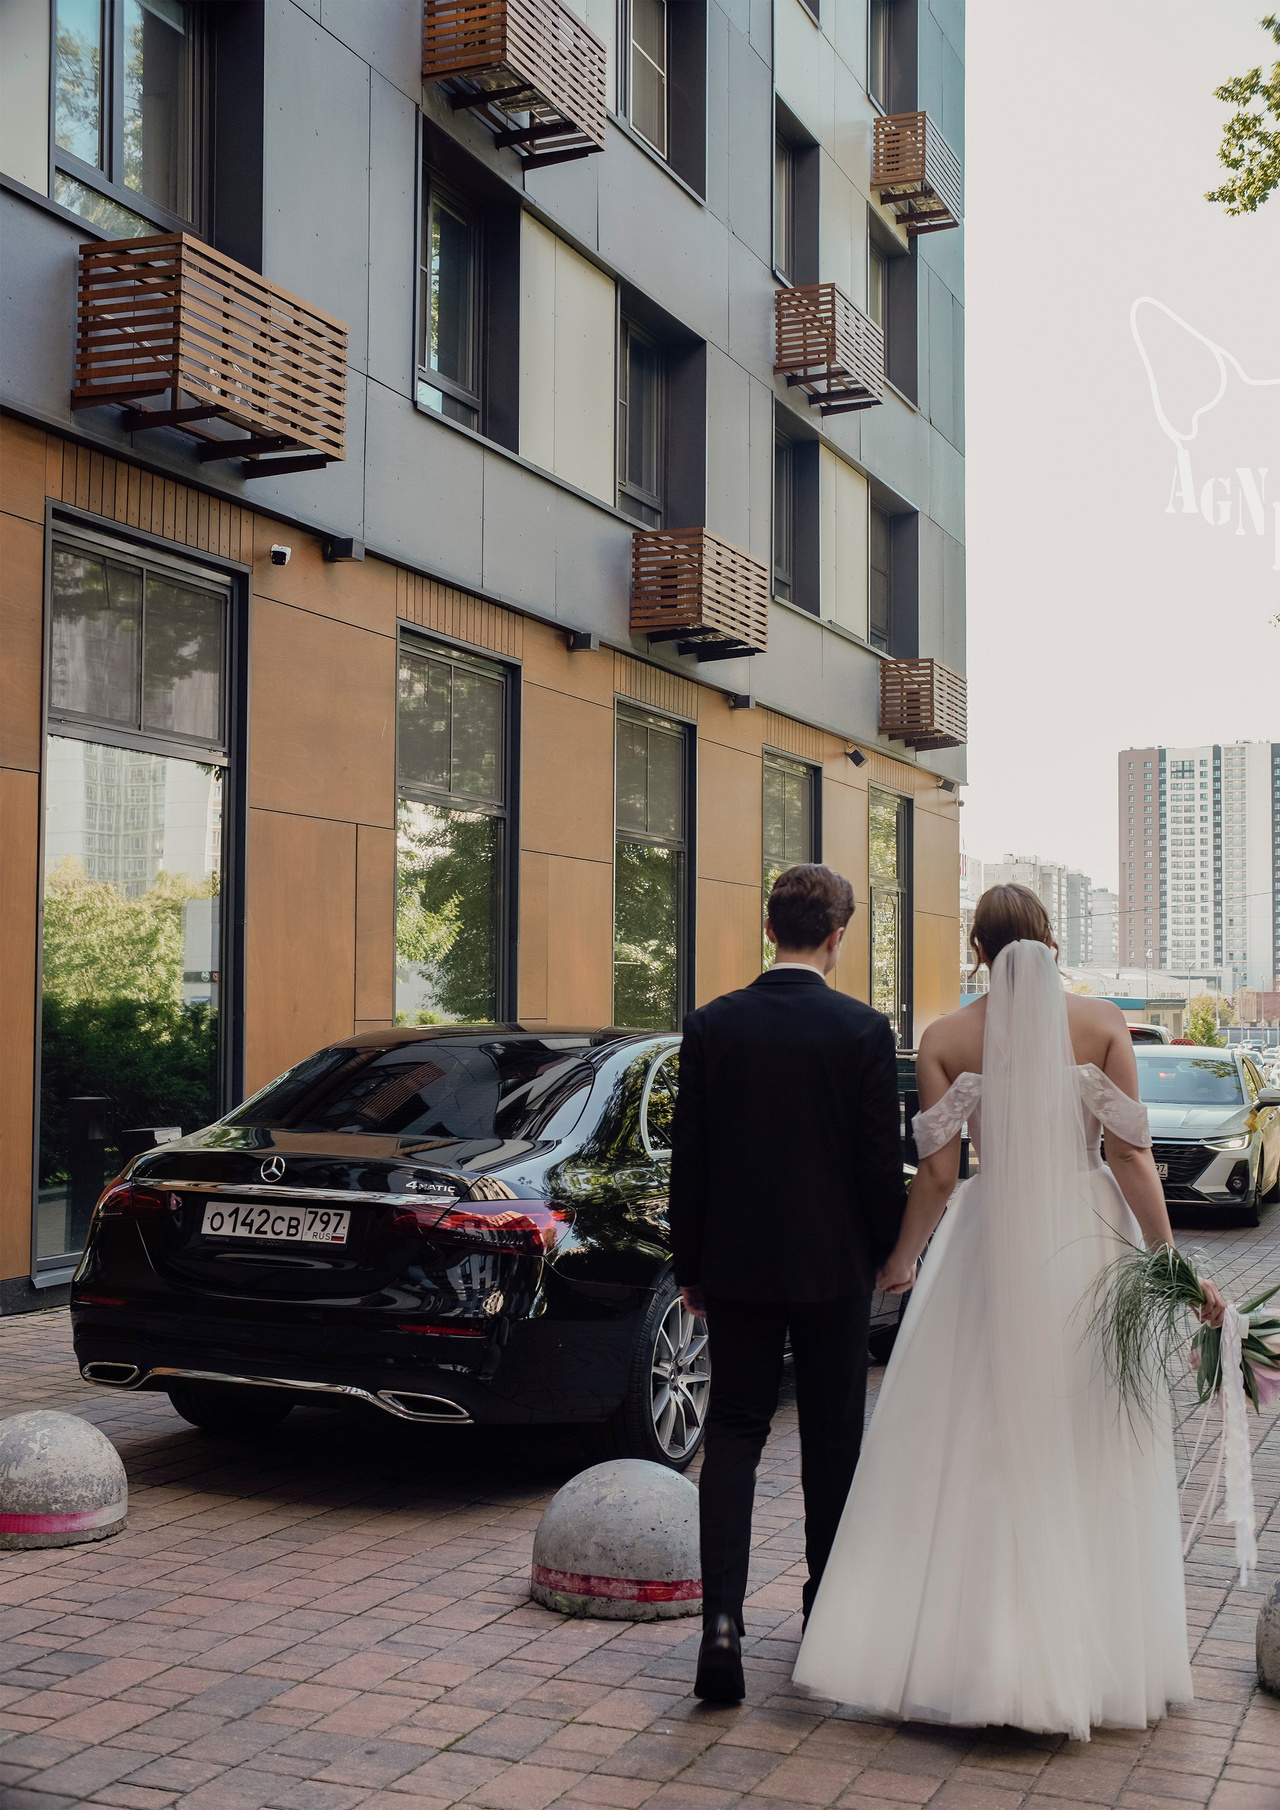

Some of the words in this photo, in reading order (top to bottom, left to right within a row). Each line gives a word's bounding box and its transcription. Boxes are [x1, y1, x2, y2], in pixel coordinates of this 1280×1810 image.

[405, 1180, 456, 1193] 4MATIC
[307, 1210, 345, 1233] 797
[312, 1231, 331, 1241] RUS
